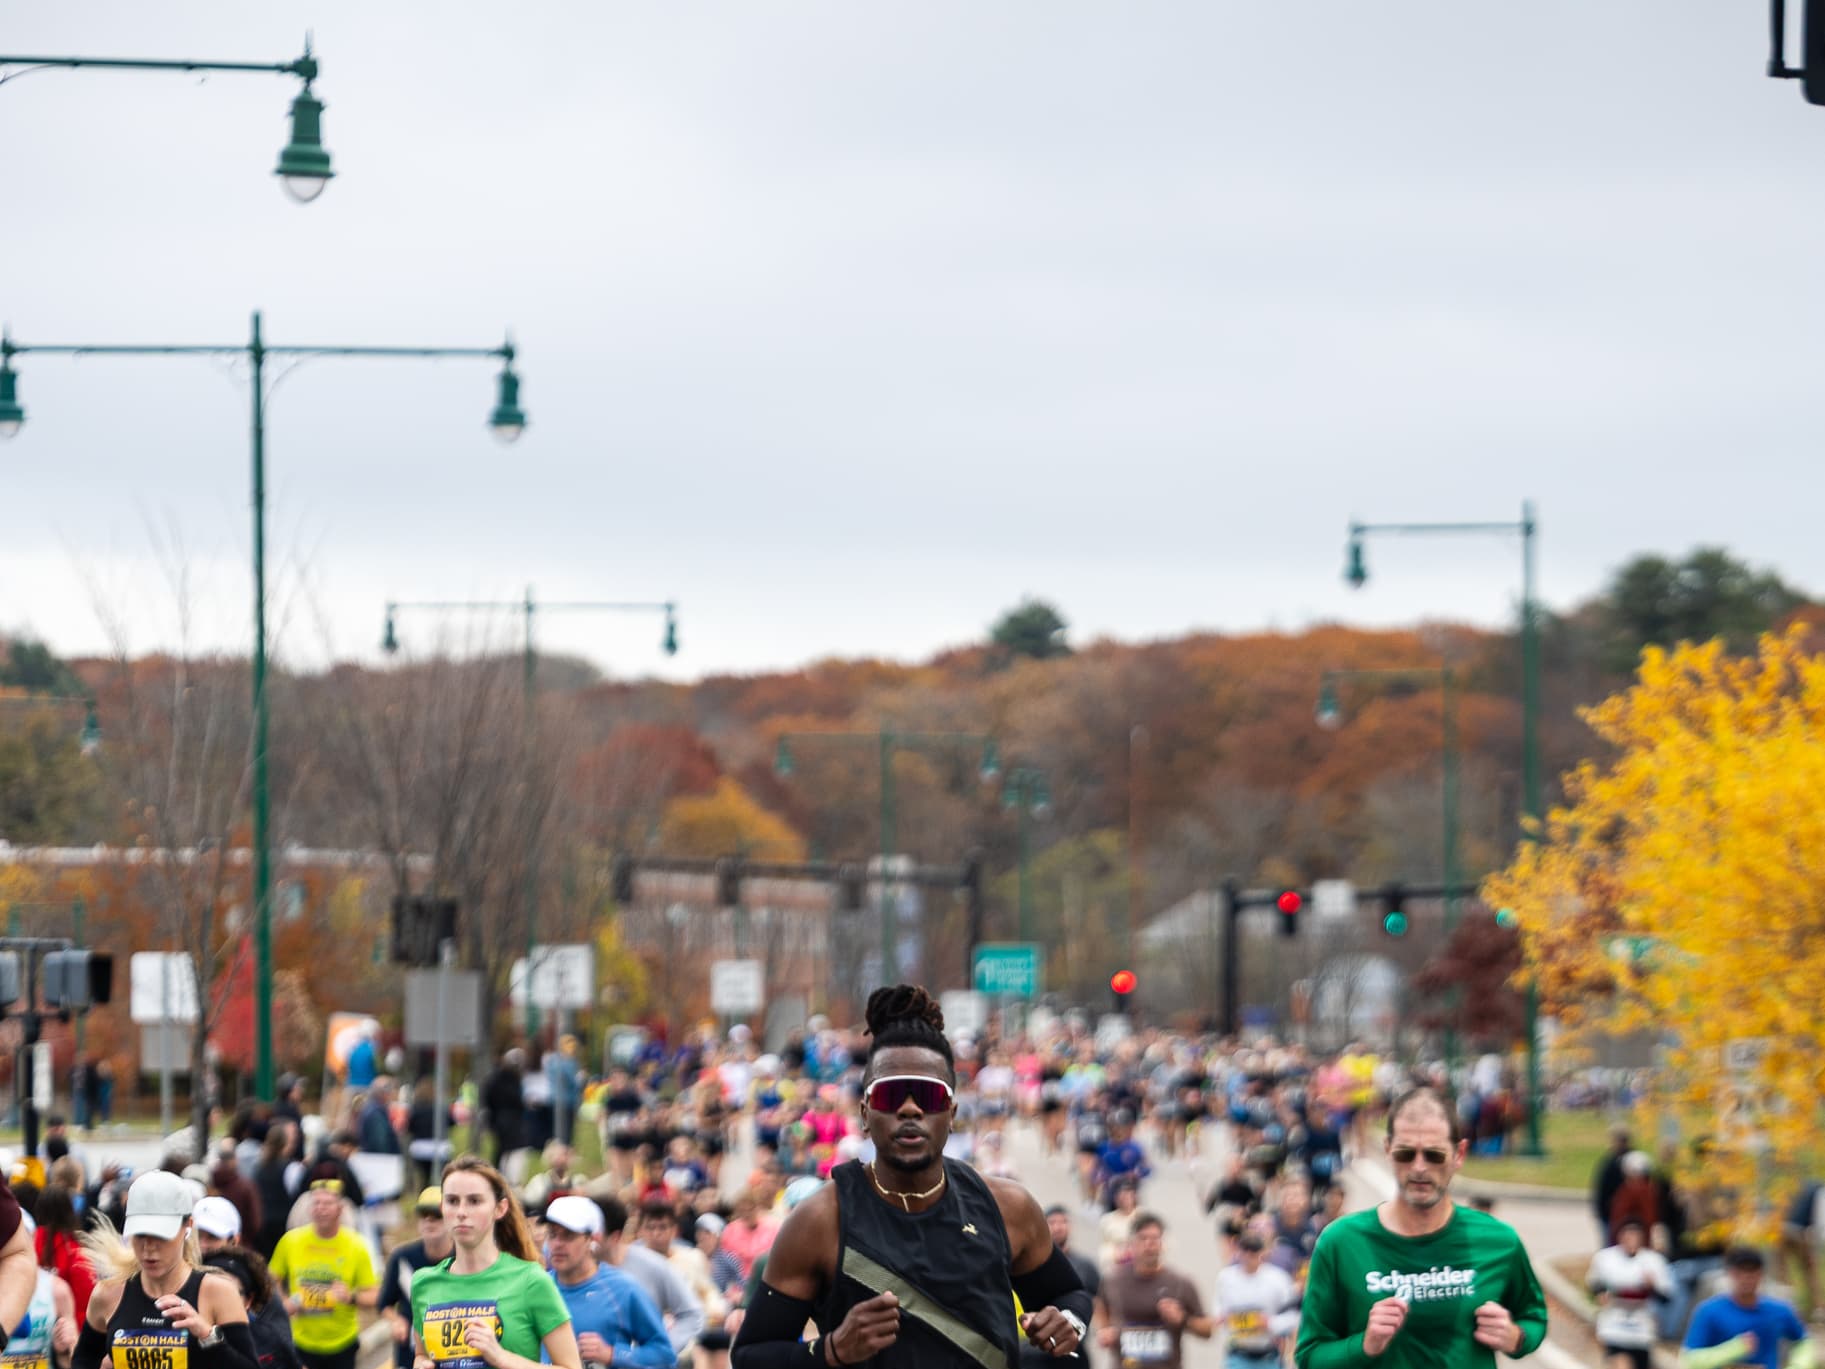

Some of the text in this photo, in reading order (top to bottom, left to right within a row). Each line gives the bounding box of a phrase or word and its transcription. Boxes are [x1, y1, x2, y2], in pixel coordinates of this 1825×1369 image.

[1365, 1266, 1477, 1293] Schneider
[1413, 1284, 1476, 1301] Electric
[467, 1306, 496, 1316] HALF
[159, 1335, 187, 1345] HALF
